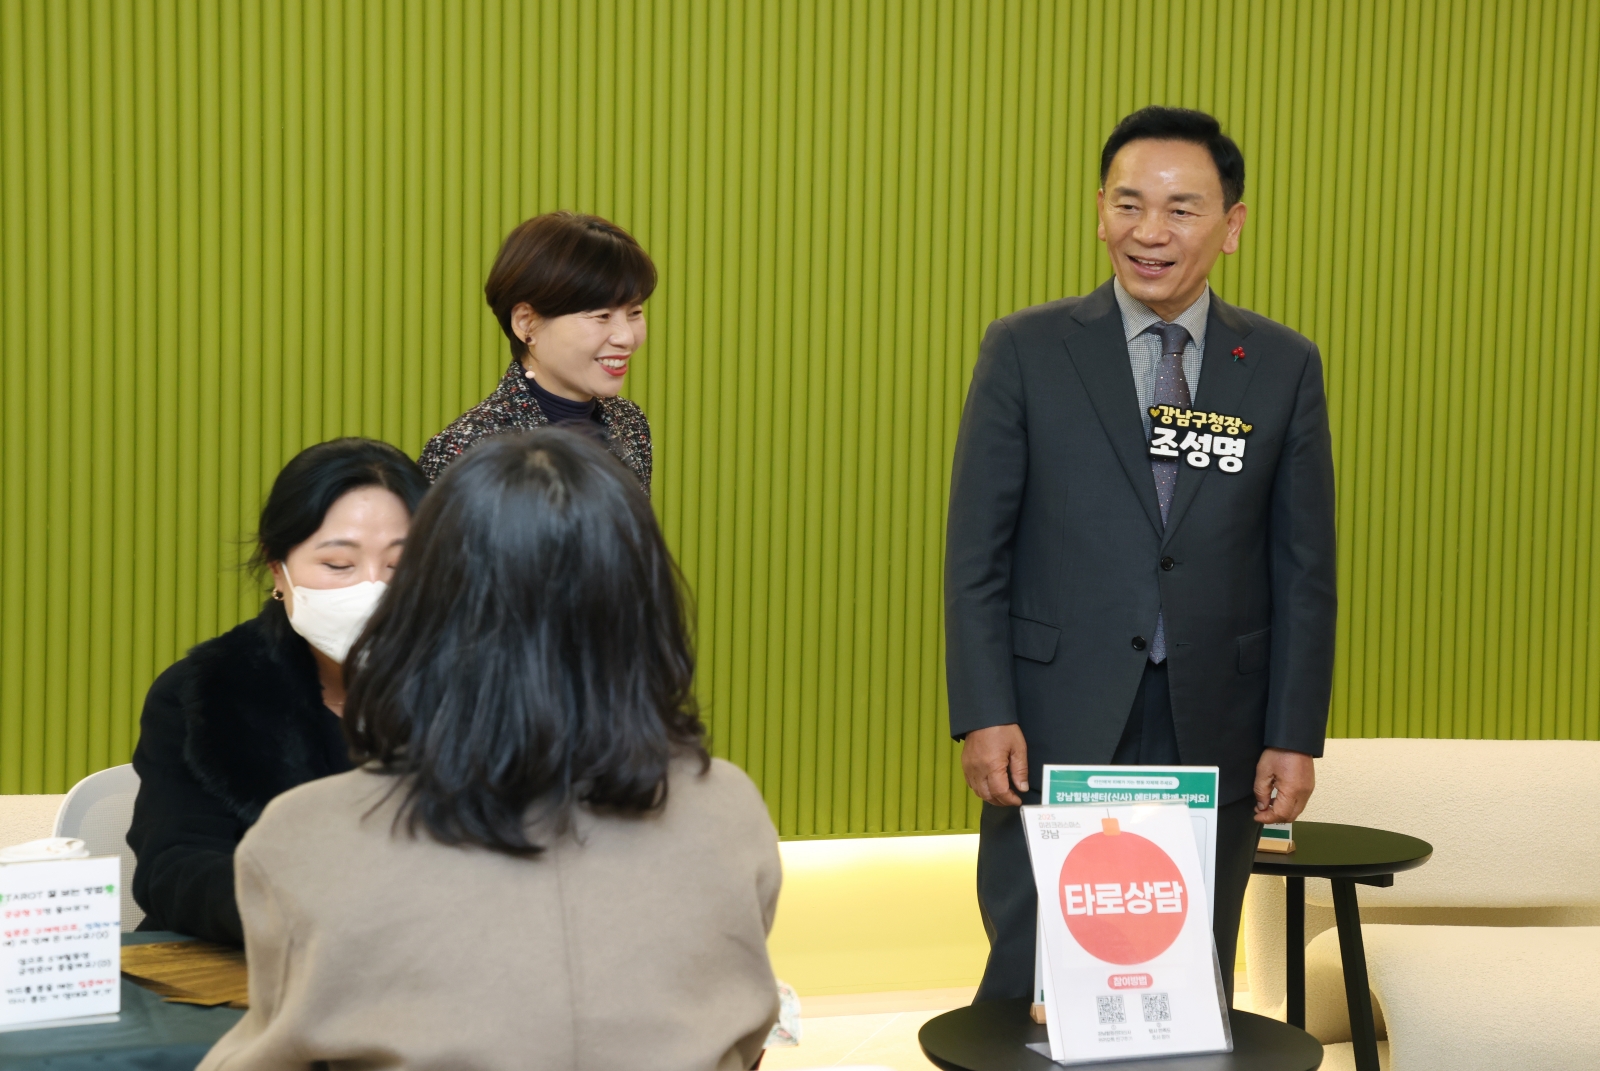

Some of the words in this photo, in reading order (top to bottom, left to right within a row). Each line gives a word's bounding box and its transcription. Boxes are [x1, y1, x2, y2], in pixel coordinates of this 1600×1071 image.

[1158, 405, 1243, 435] 강남구청장
[1150, 427, 1246, 473] 조성명
[1056, 792, 1133, 803] 강남힐링센터(신사)
[1037, 813, 1056, 821] 2025
[1039, 821, 1082, 829] 미리크리스마스
[1040, 829, 1060, 840] 강남
[6, 891, 43, 902] TAROT
[1064, 881, 1183, 916] 타로상담
[1113, 975, 1148, 987] 참여방법
